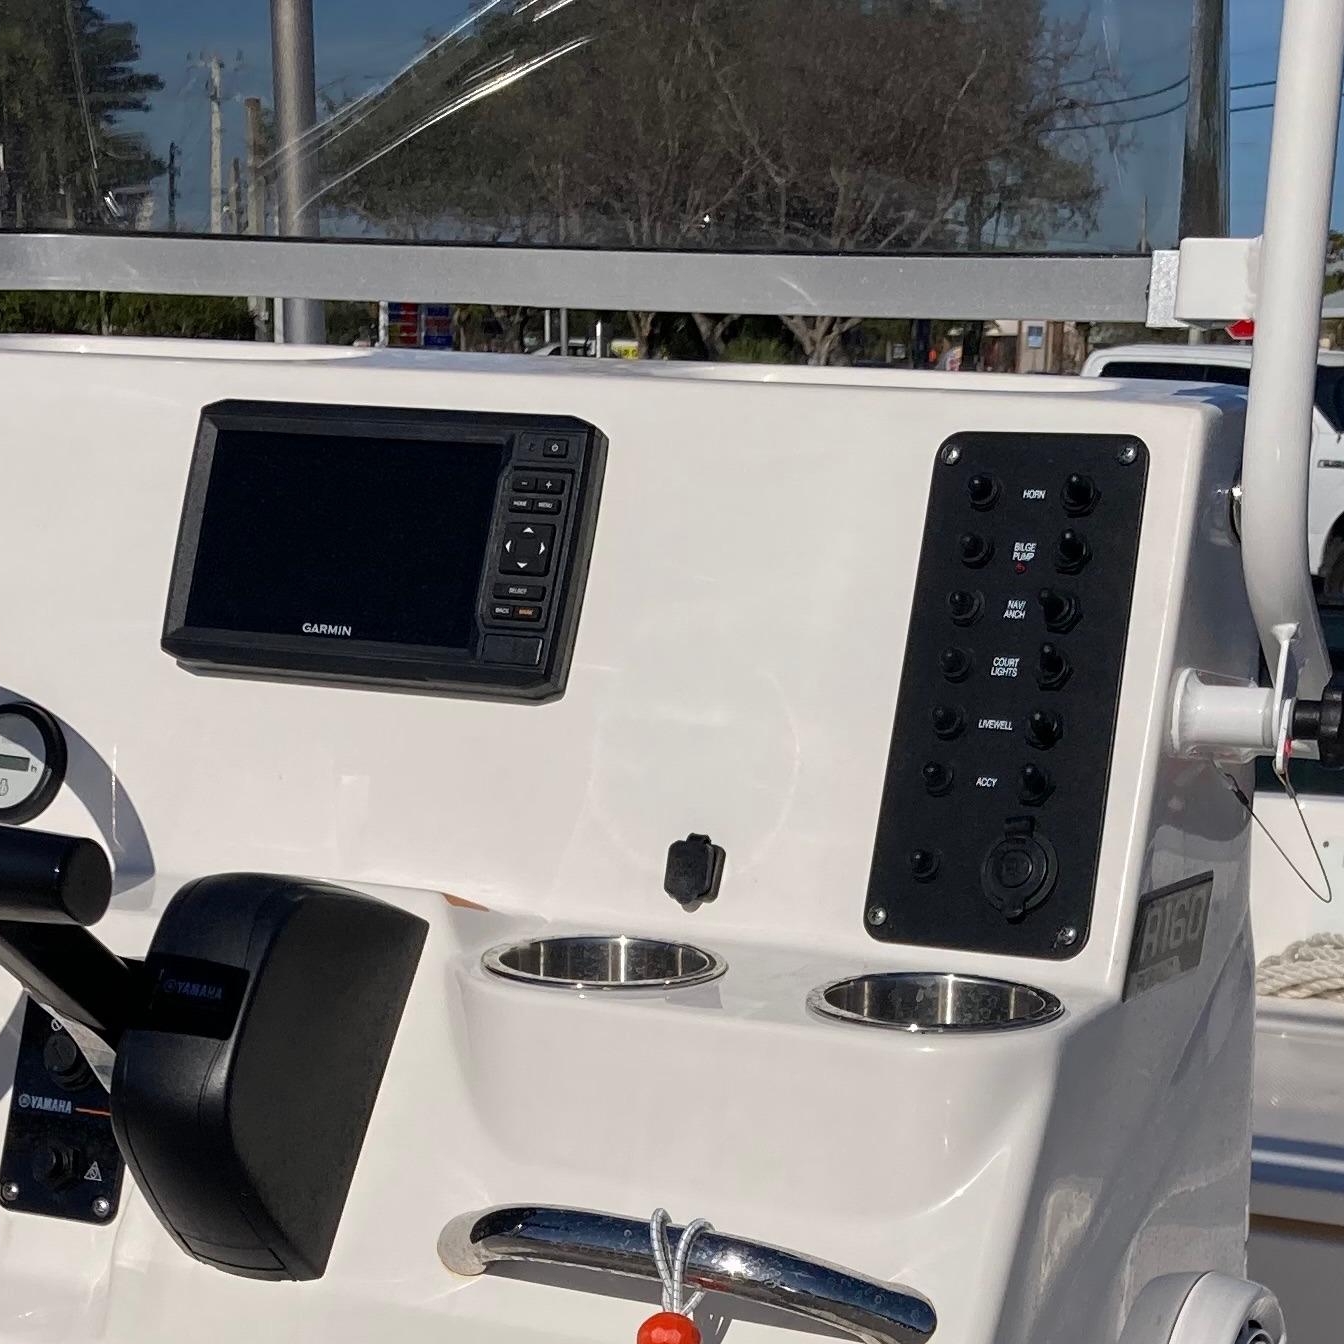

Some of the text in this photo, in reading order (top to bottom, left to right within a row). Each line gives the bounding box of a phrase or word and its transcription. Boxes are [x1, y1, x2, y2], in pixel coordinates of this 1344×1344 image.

[1022, 489, 1046, 500] HORN
[1014, 541, 1037, 553] BILGE
[1012, 551, 1035, 562] PUMP
[1003, 609, 1026, 620] ANCH
[302, 622, 352, 637] GARMIN
[993, 656, 1020, 667] COURT
[990, 666, 1018, 678] LIGHTS
[978, 718, 1013, 732] LIVEWELL
[30, 1095, 72, 1115] YAMAHA
